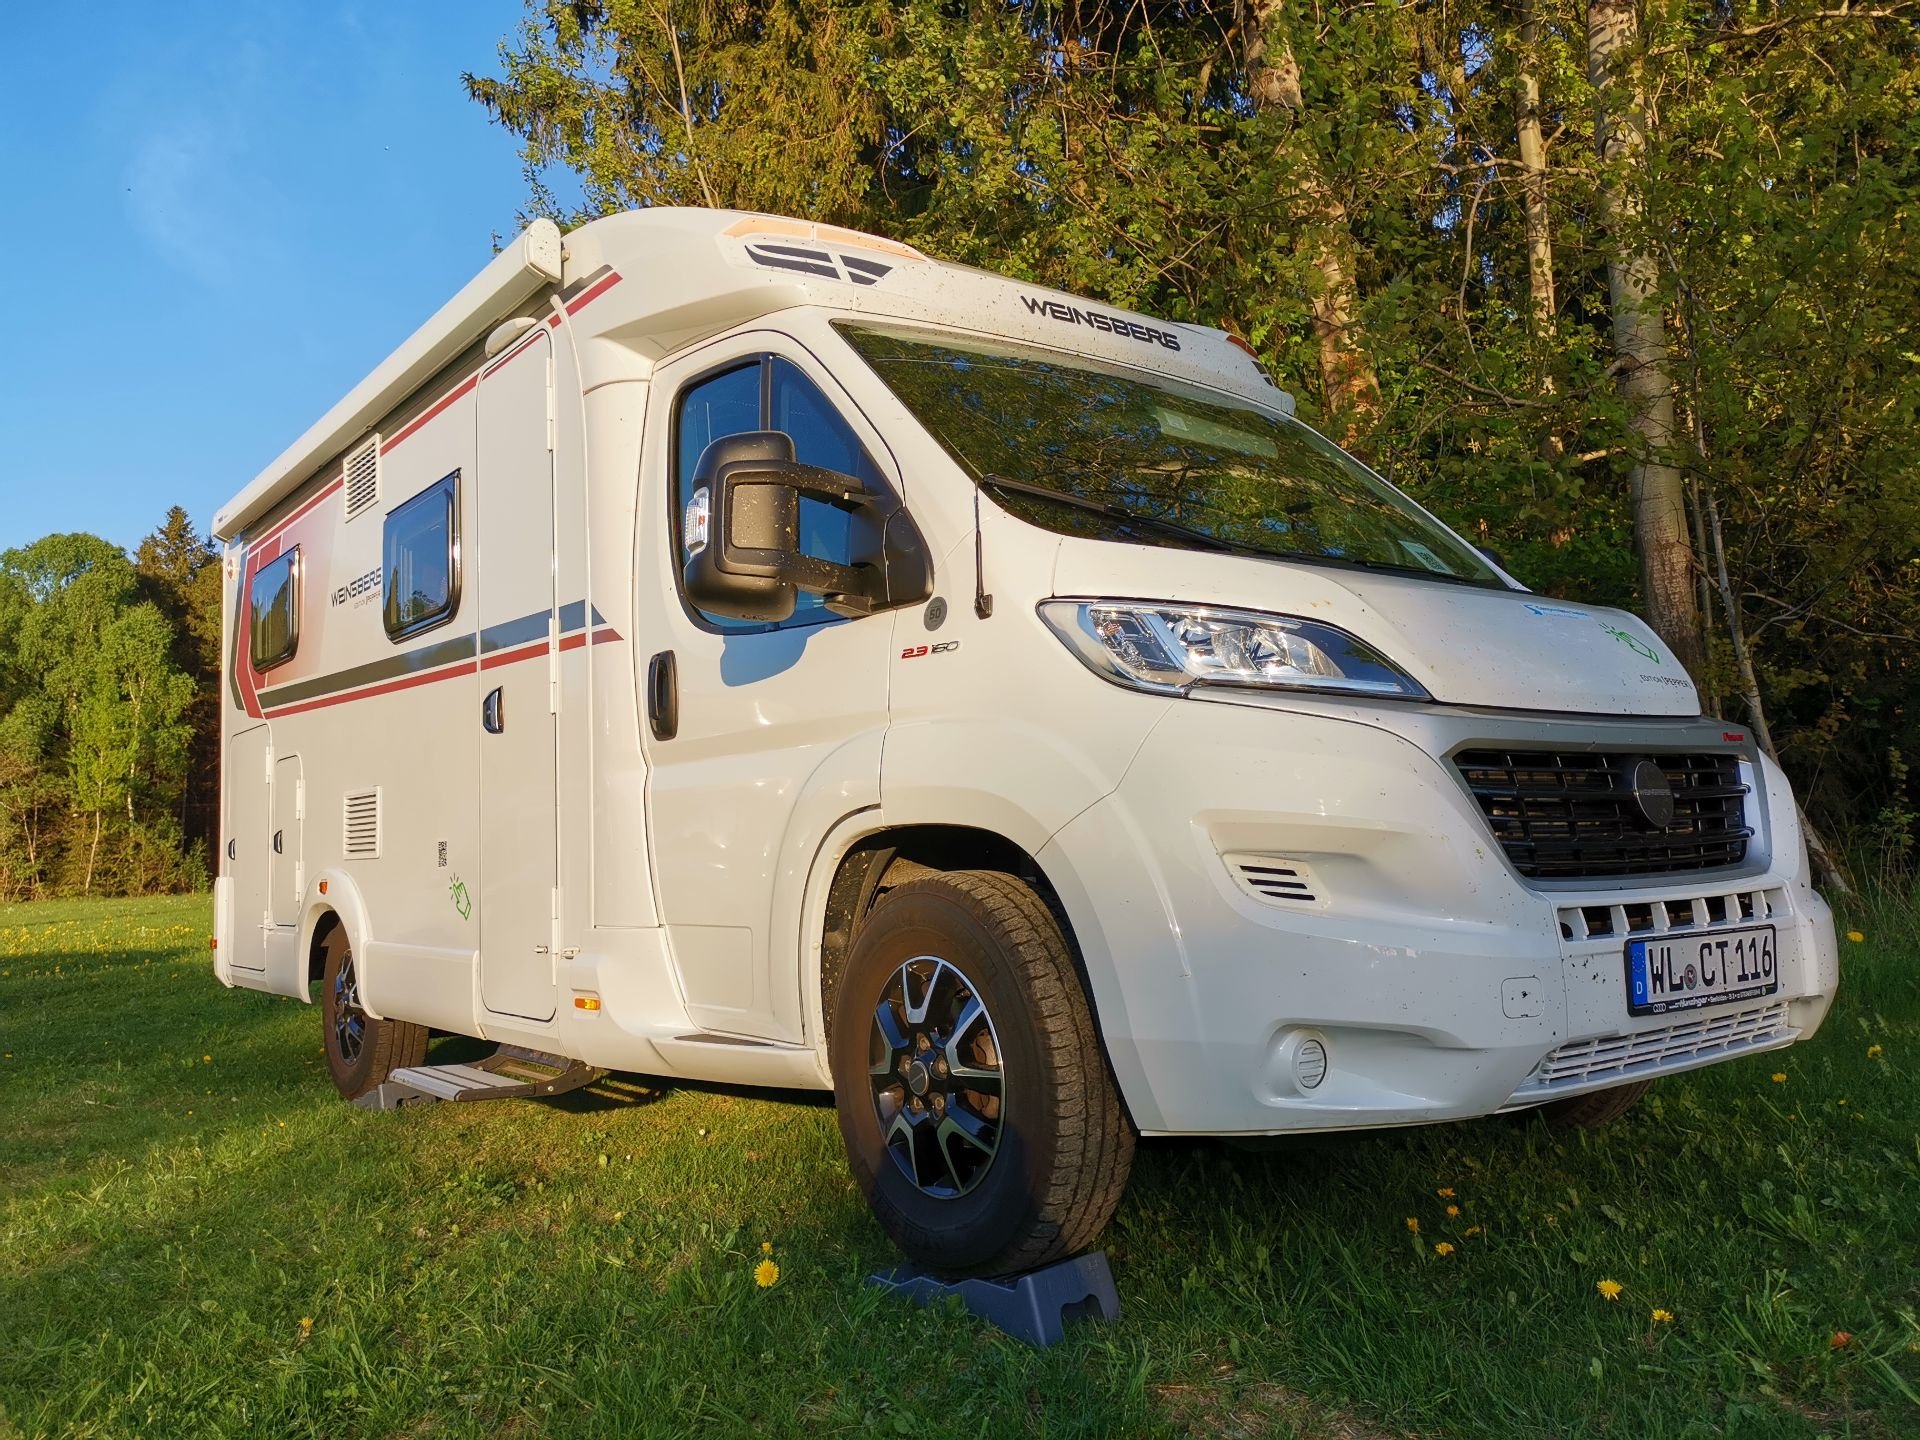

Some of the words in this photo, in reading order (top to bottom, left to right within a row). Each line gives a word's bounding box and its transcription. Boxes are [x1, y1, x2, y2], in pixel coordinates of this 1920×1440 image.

[1020, 295, 1181, 351] WEINSBERG
[331, 567, 381, 607] WEINSBERG
[1636, 981, 1643, 995] D
[1649, 947, 1684, 994] WL
[1700, 941, 1728, 986] CT
[1735, 935, 1772, 982] 116
